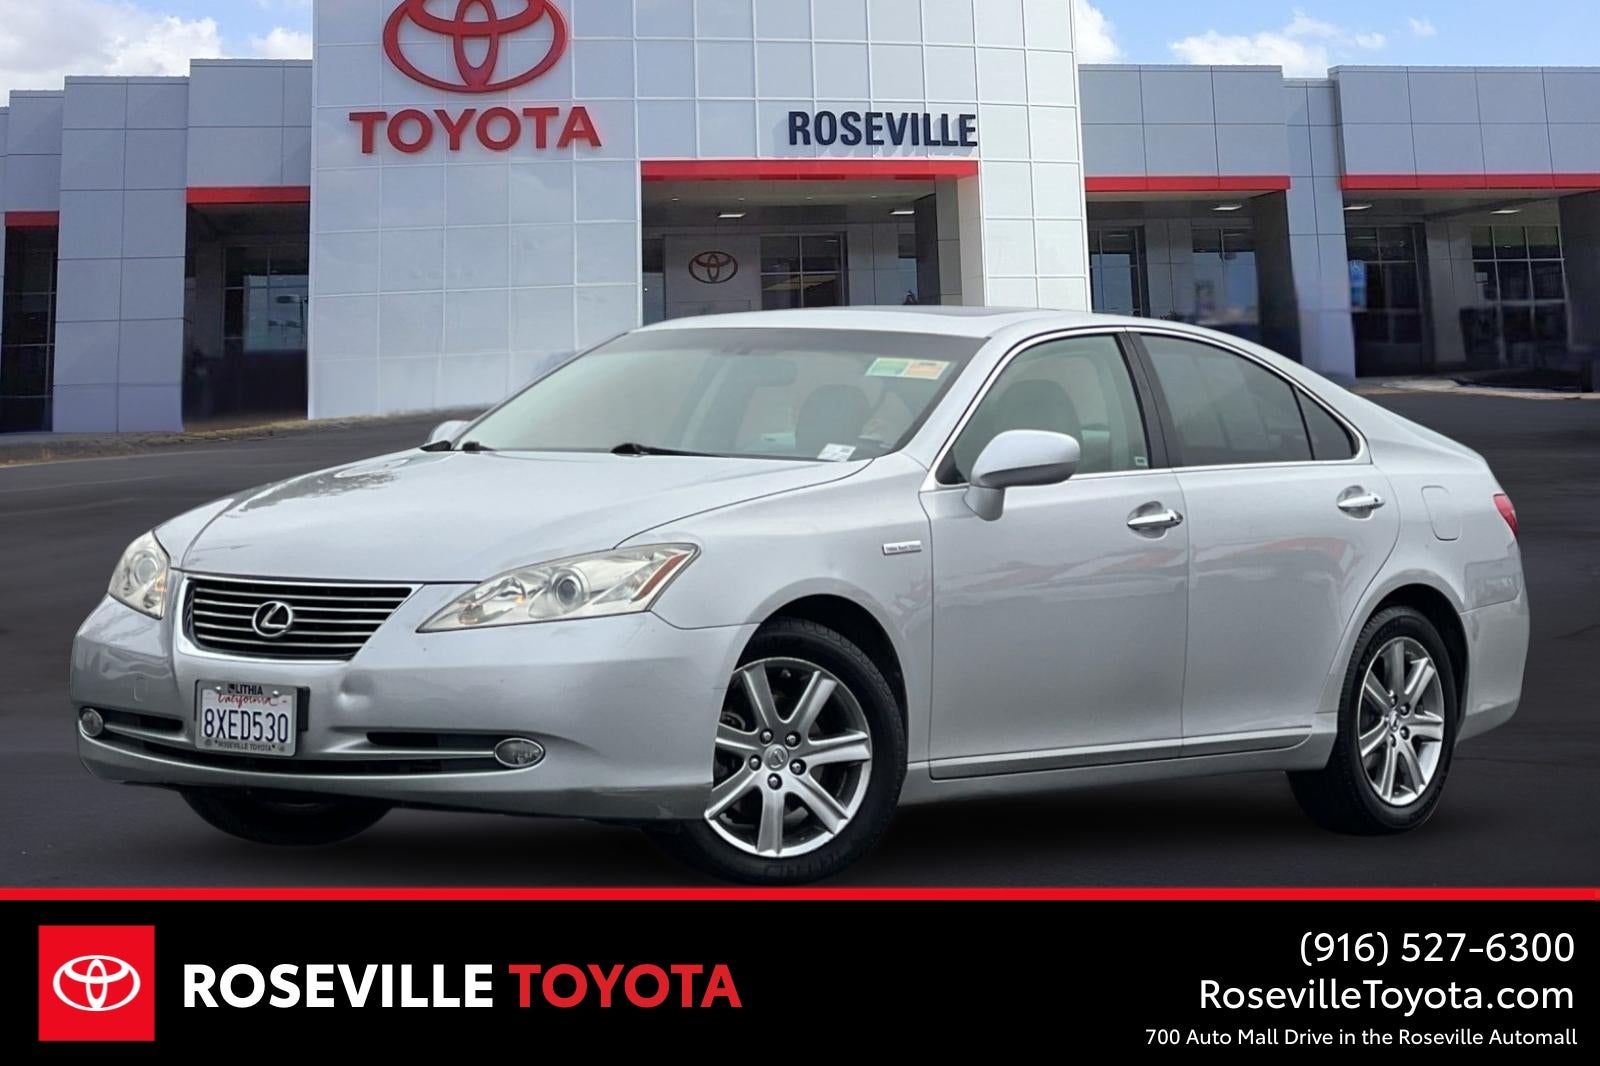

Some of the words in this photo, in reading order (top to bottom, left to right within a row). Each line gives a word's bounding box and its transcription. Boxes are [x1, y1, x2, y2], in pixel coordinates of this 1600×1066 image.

[350, 106, 602, 153] TOYOTA
[788, 110, 978, 148] ROSEVILLE
[218, 692, 277, 708] California
[236, 683, 263, 695] LITHIA
[204, 708, 289, 743] 8XED530
